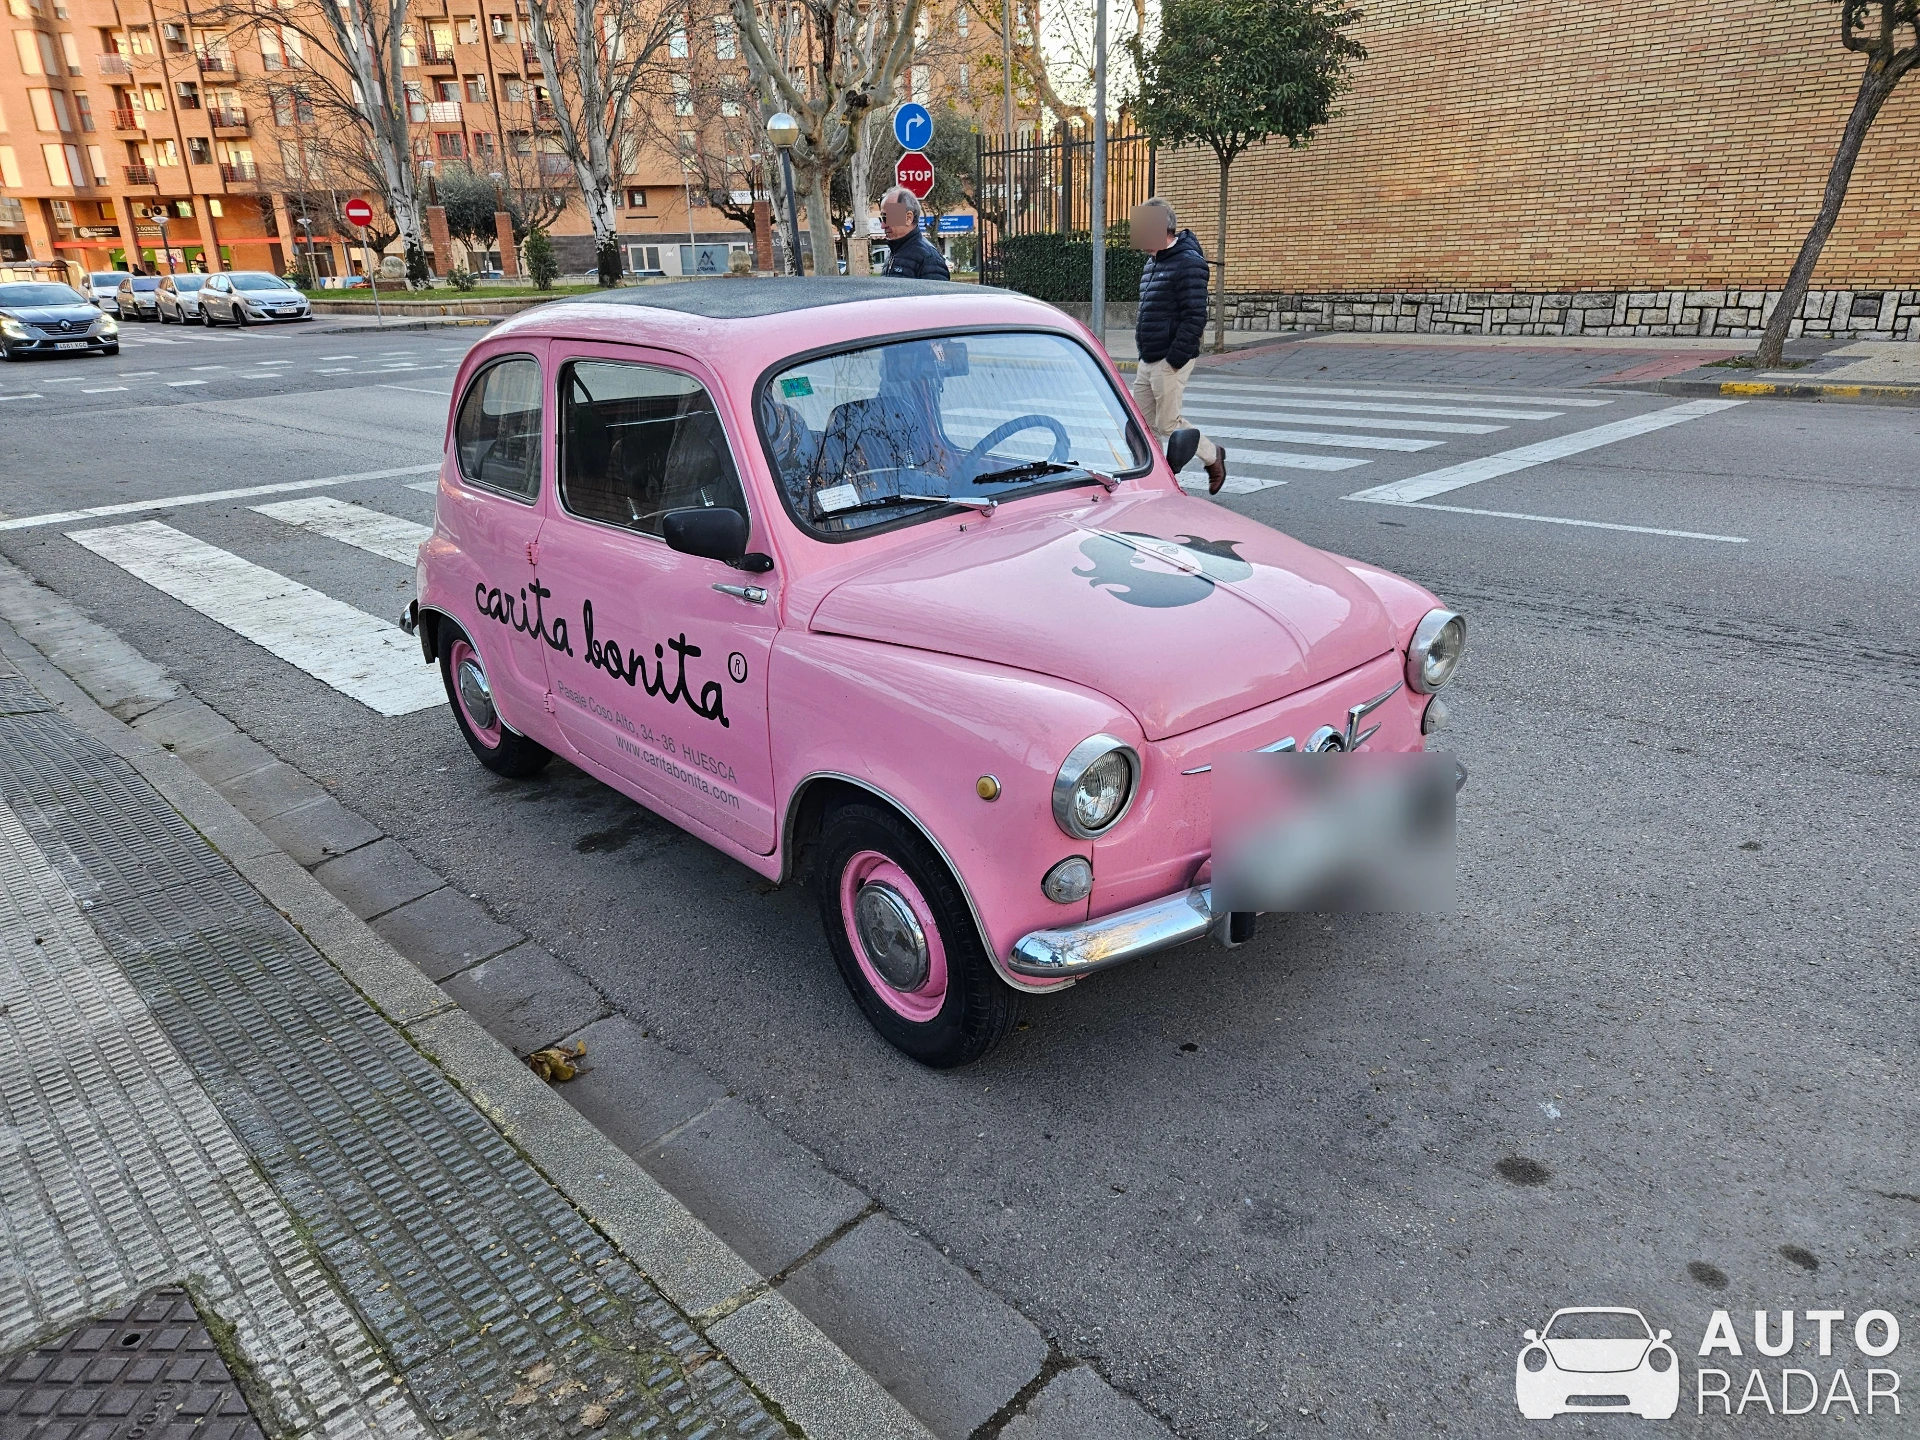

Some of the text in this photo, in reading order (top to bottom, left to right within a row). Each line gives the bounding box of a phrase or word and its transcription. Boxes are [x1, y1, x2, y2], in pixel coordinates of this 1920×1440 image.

[899, 170, 932, 182] STOP
[475, 578, 574, 658] carita
[583, 599, 730, 728] bonita
[557, 680, 587, 708] Pasaje
[588, 696, 613, 722] Coso
[682, 743, 738, 784] HUESCA
[615, 735, 740, 810] www.caritabonita.com
